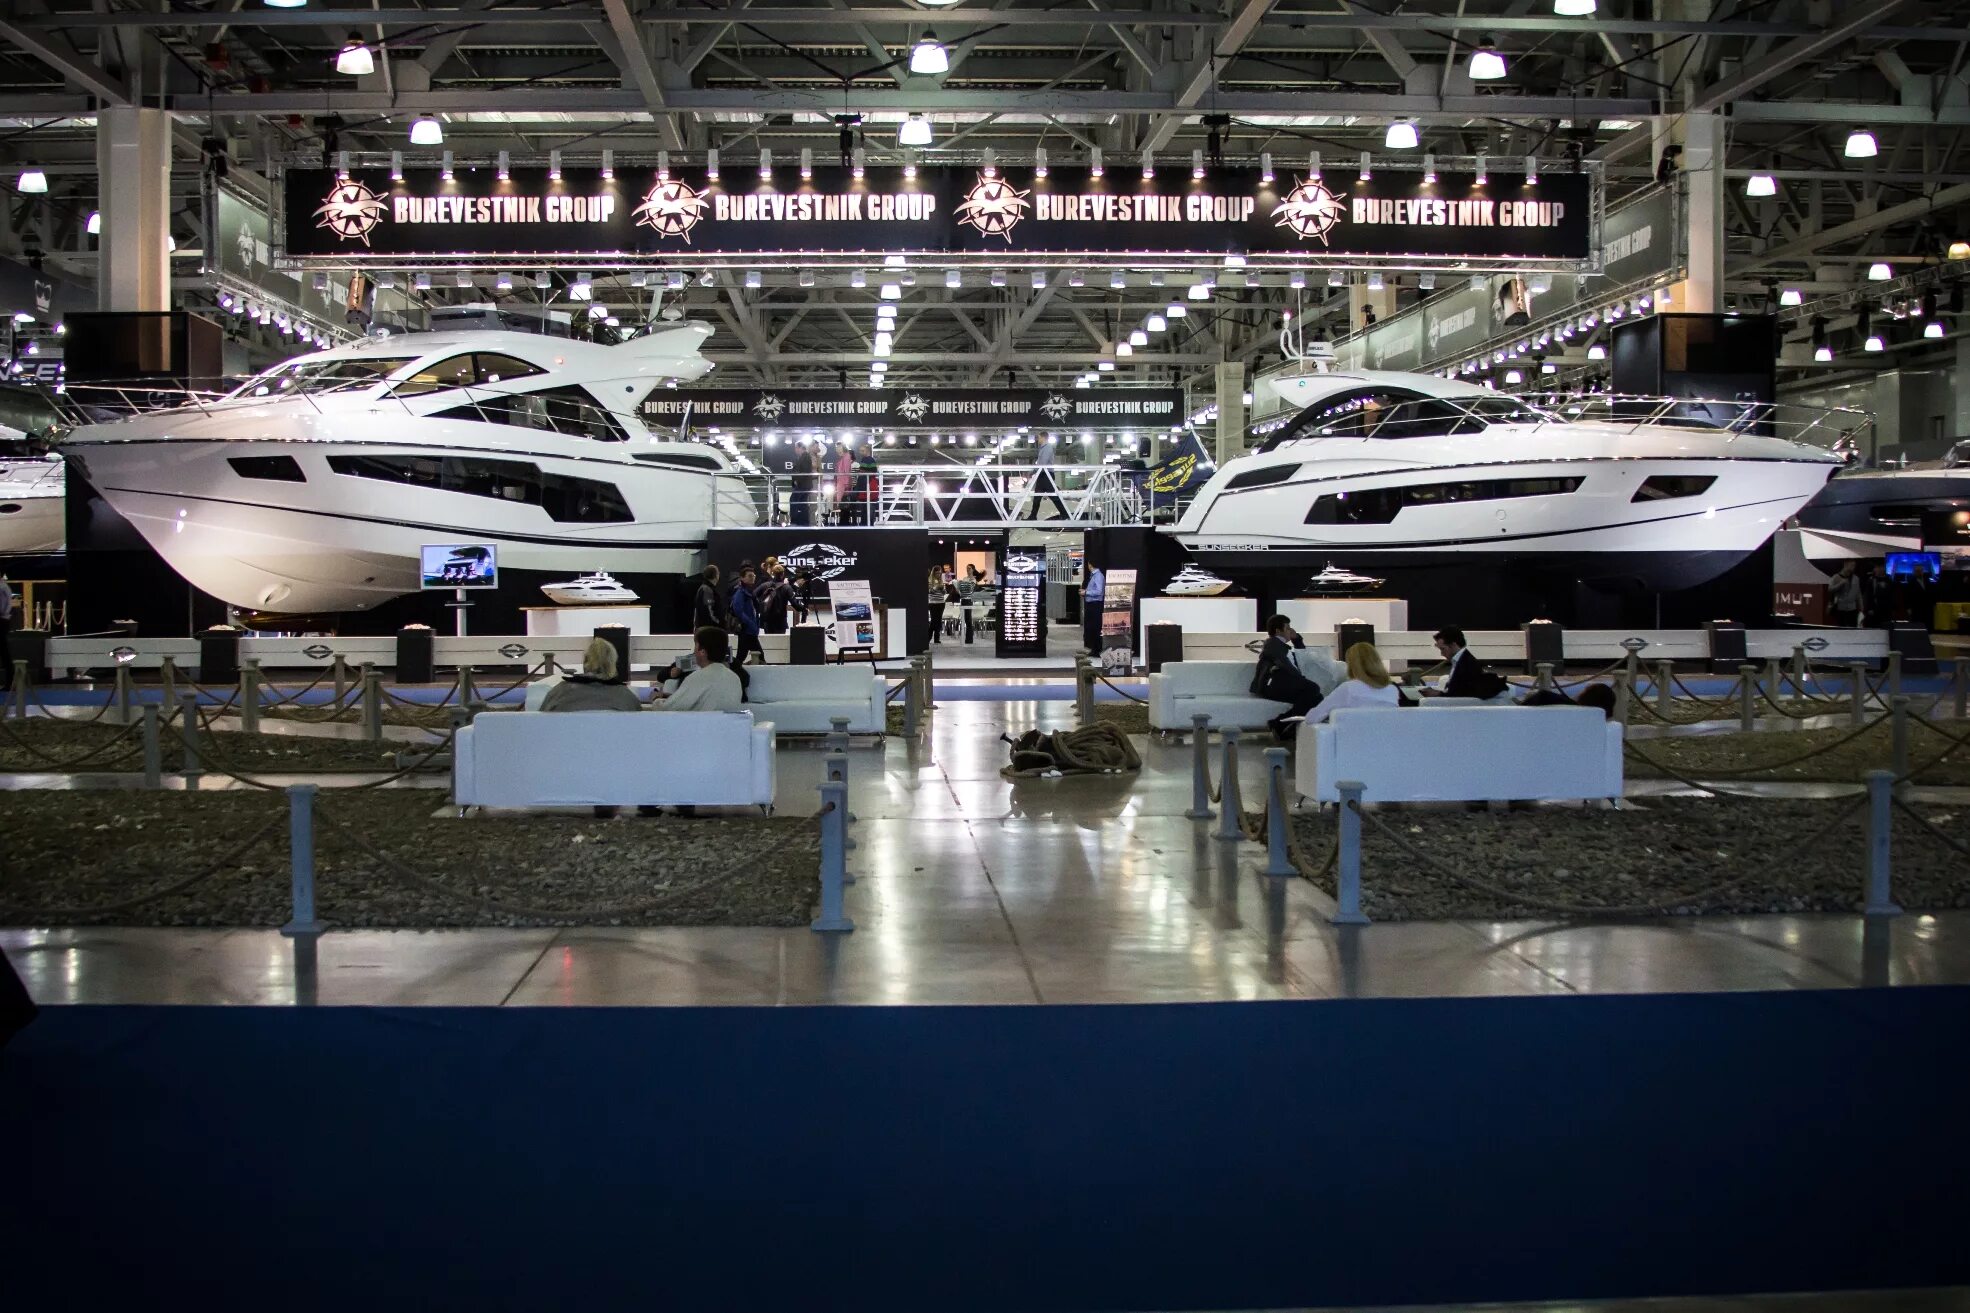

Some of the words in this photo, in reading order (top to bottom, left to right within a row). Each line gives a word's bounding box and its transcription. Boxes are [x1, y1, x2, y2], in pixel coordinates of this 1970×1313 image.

[393, 196, 540, 223] BUREVESTNIK
[546, 195, 620, 223] GROUP
[715, 194, 863, 221] BUREVESTNIK
[867, 195, 936, 221] GROUP
[1036, 194, 1182, 221] BUREVESTNIK
[1186, 195, 1255, 222] GROUP
[1352, 198, 1495, 226] BUREVESTNIK
[1499, 201, 1565, 227] GROUP
[712, 402, 744, 414] GROUP
[788, 401, 855, 414] BUREVESTNIK
[857, 402, 888, 414] GROUP
[932, 401, 999, 414] BUREVESTNIK
[1000, 402, 1032, 414] GROUP
[1075, 401, 1141, 414] BUREVESTNIK
[1143, 402, 1174, 414] GROUP
[777, 555, 857, 567] Sunseker
